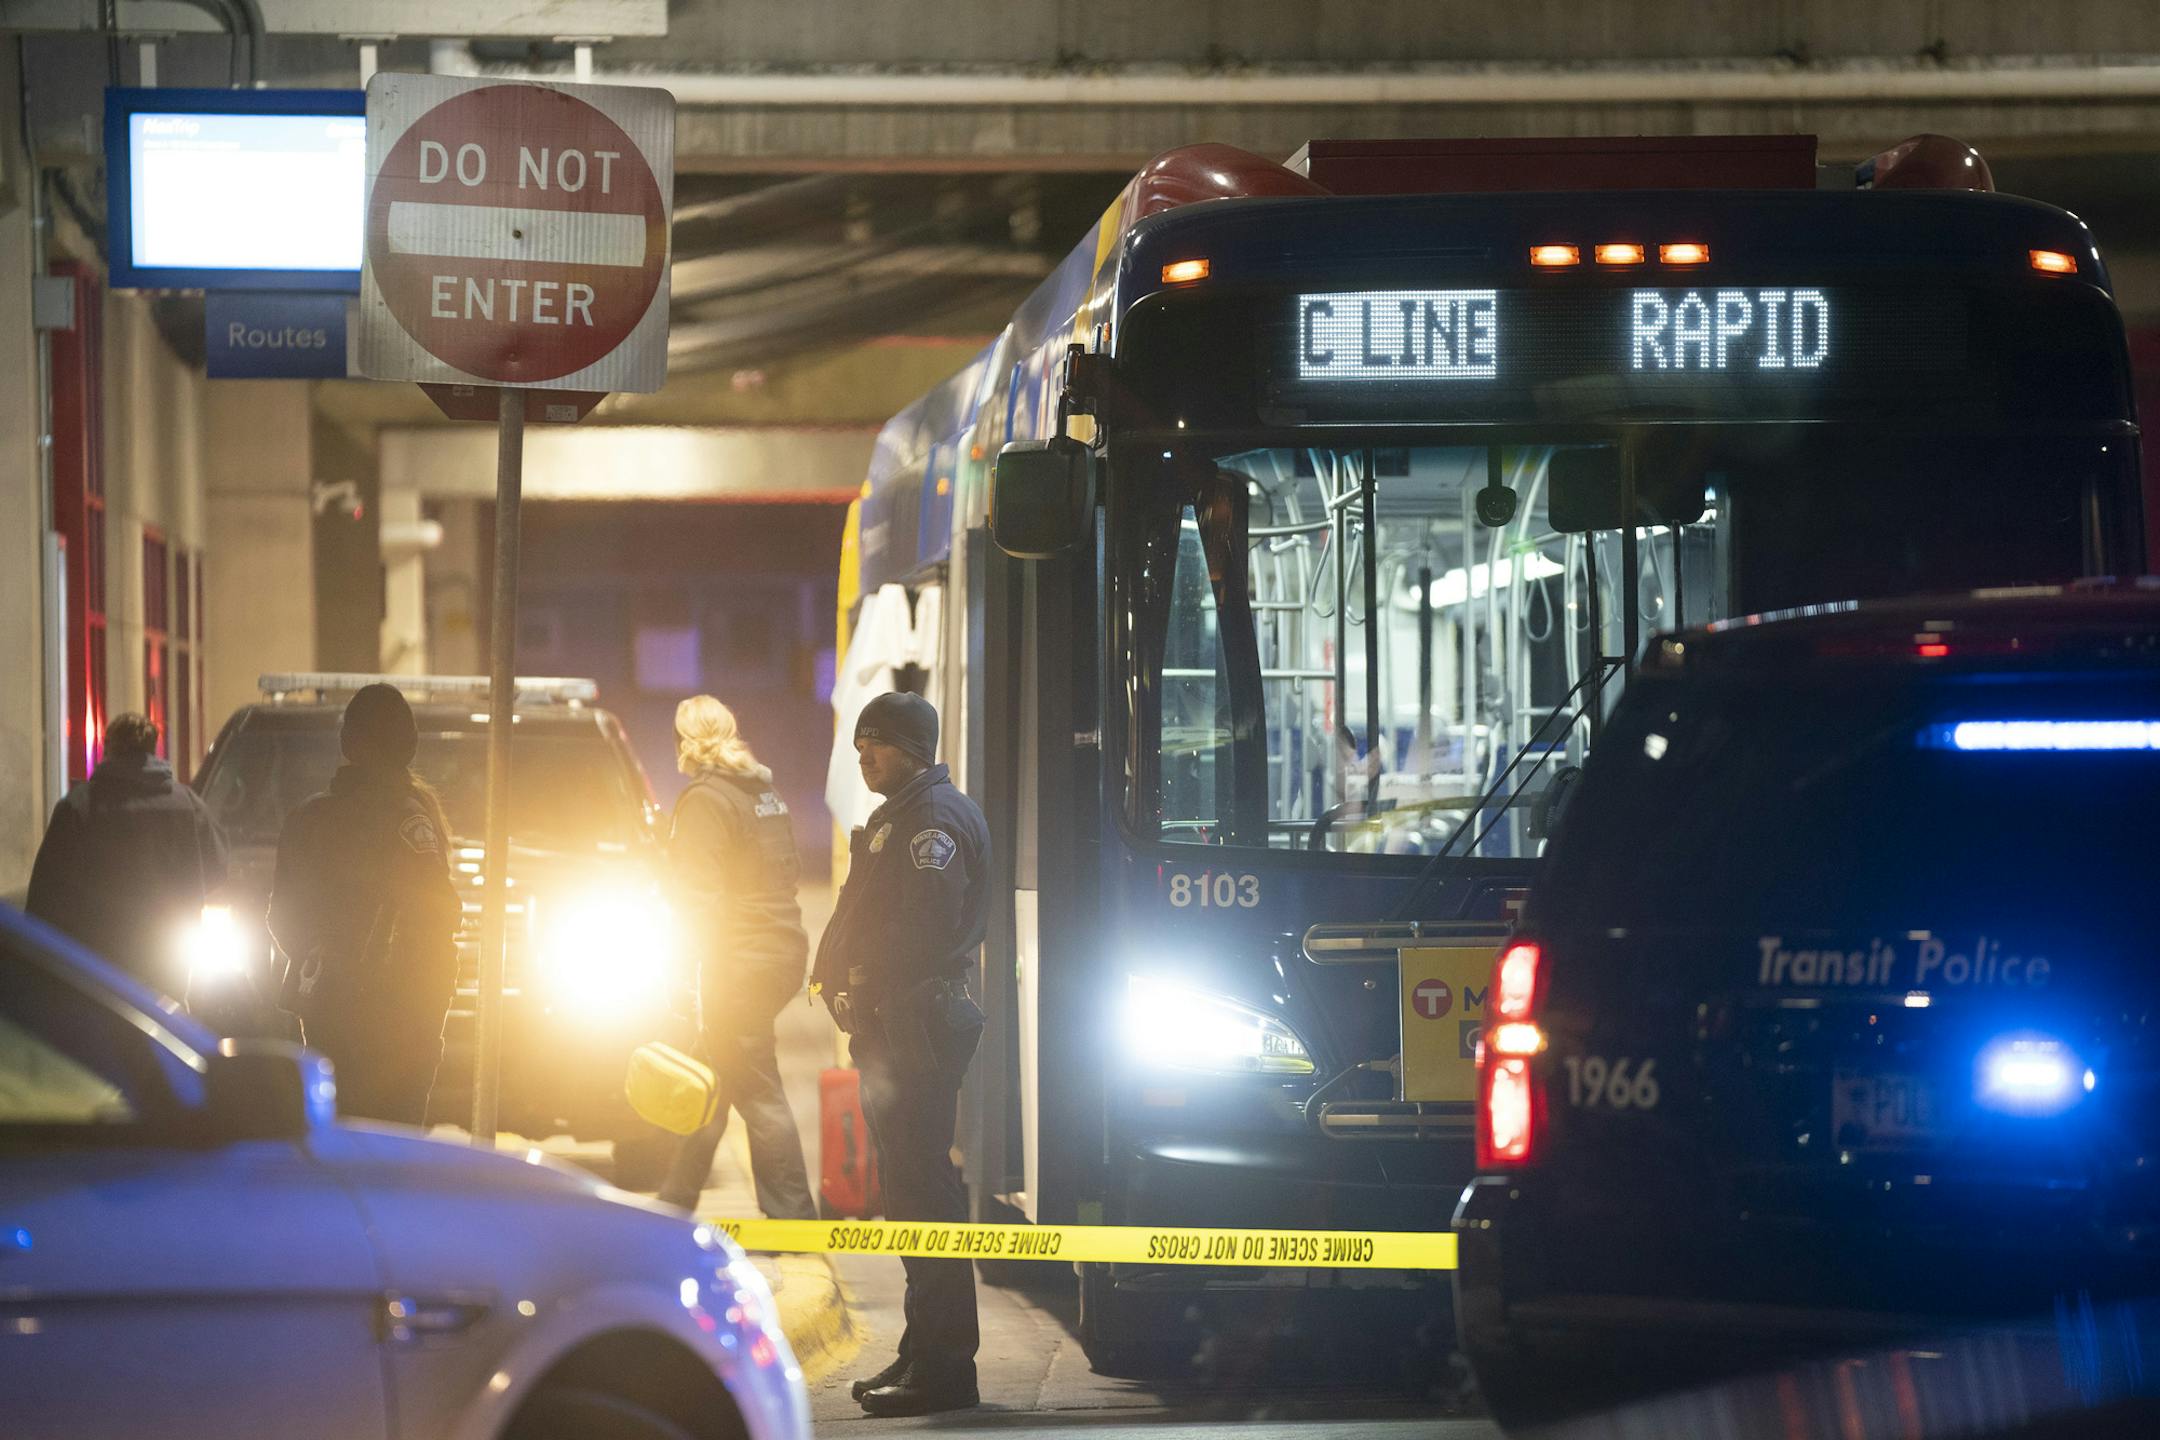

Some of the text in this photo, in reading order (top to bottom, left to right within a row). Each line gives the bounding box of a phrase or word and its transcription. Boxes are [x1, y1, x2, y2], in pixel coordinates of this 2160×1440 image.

[419, 141, 620, 194] DO NOT
[431, 275, 595, 327] ENTER
[228, 321, 327, 348] Routes
[1304, 290, 1829, 369] C LINE RAPID
[912, 832, 954, 848] MINNEAPOLIS
[1169, 873, 1260, 908] 8103
[1758, 936, 2052, 986] Transit Police
[1563, 1056, 1660, 1110] 1966
[828, 1226, 1062, 1255] CRIME SCENE DO NOT CROSS
[1148, 1235, 1374, 1262] CRIME SCENE DO NOT CROSS
